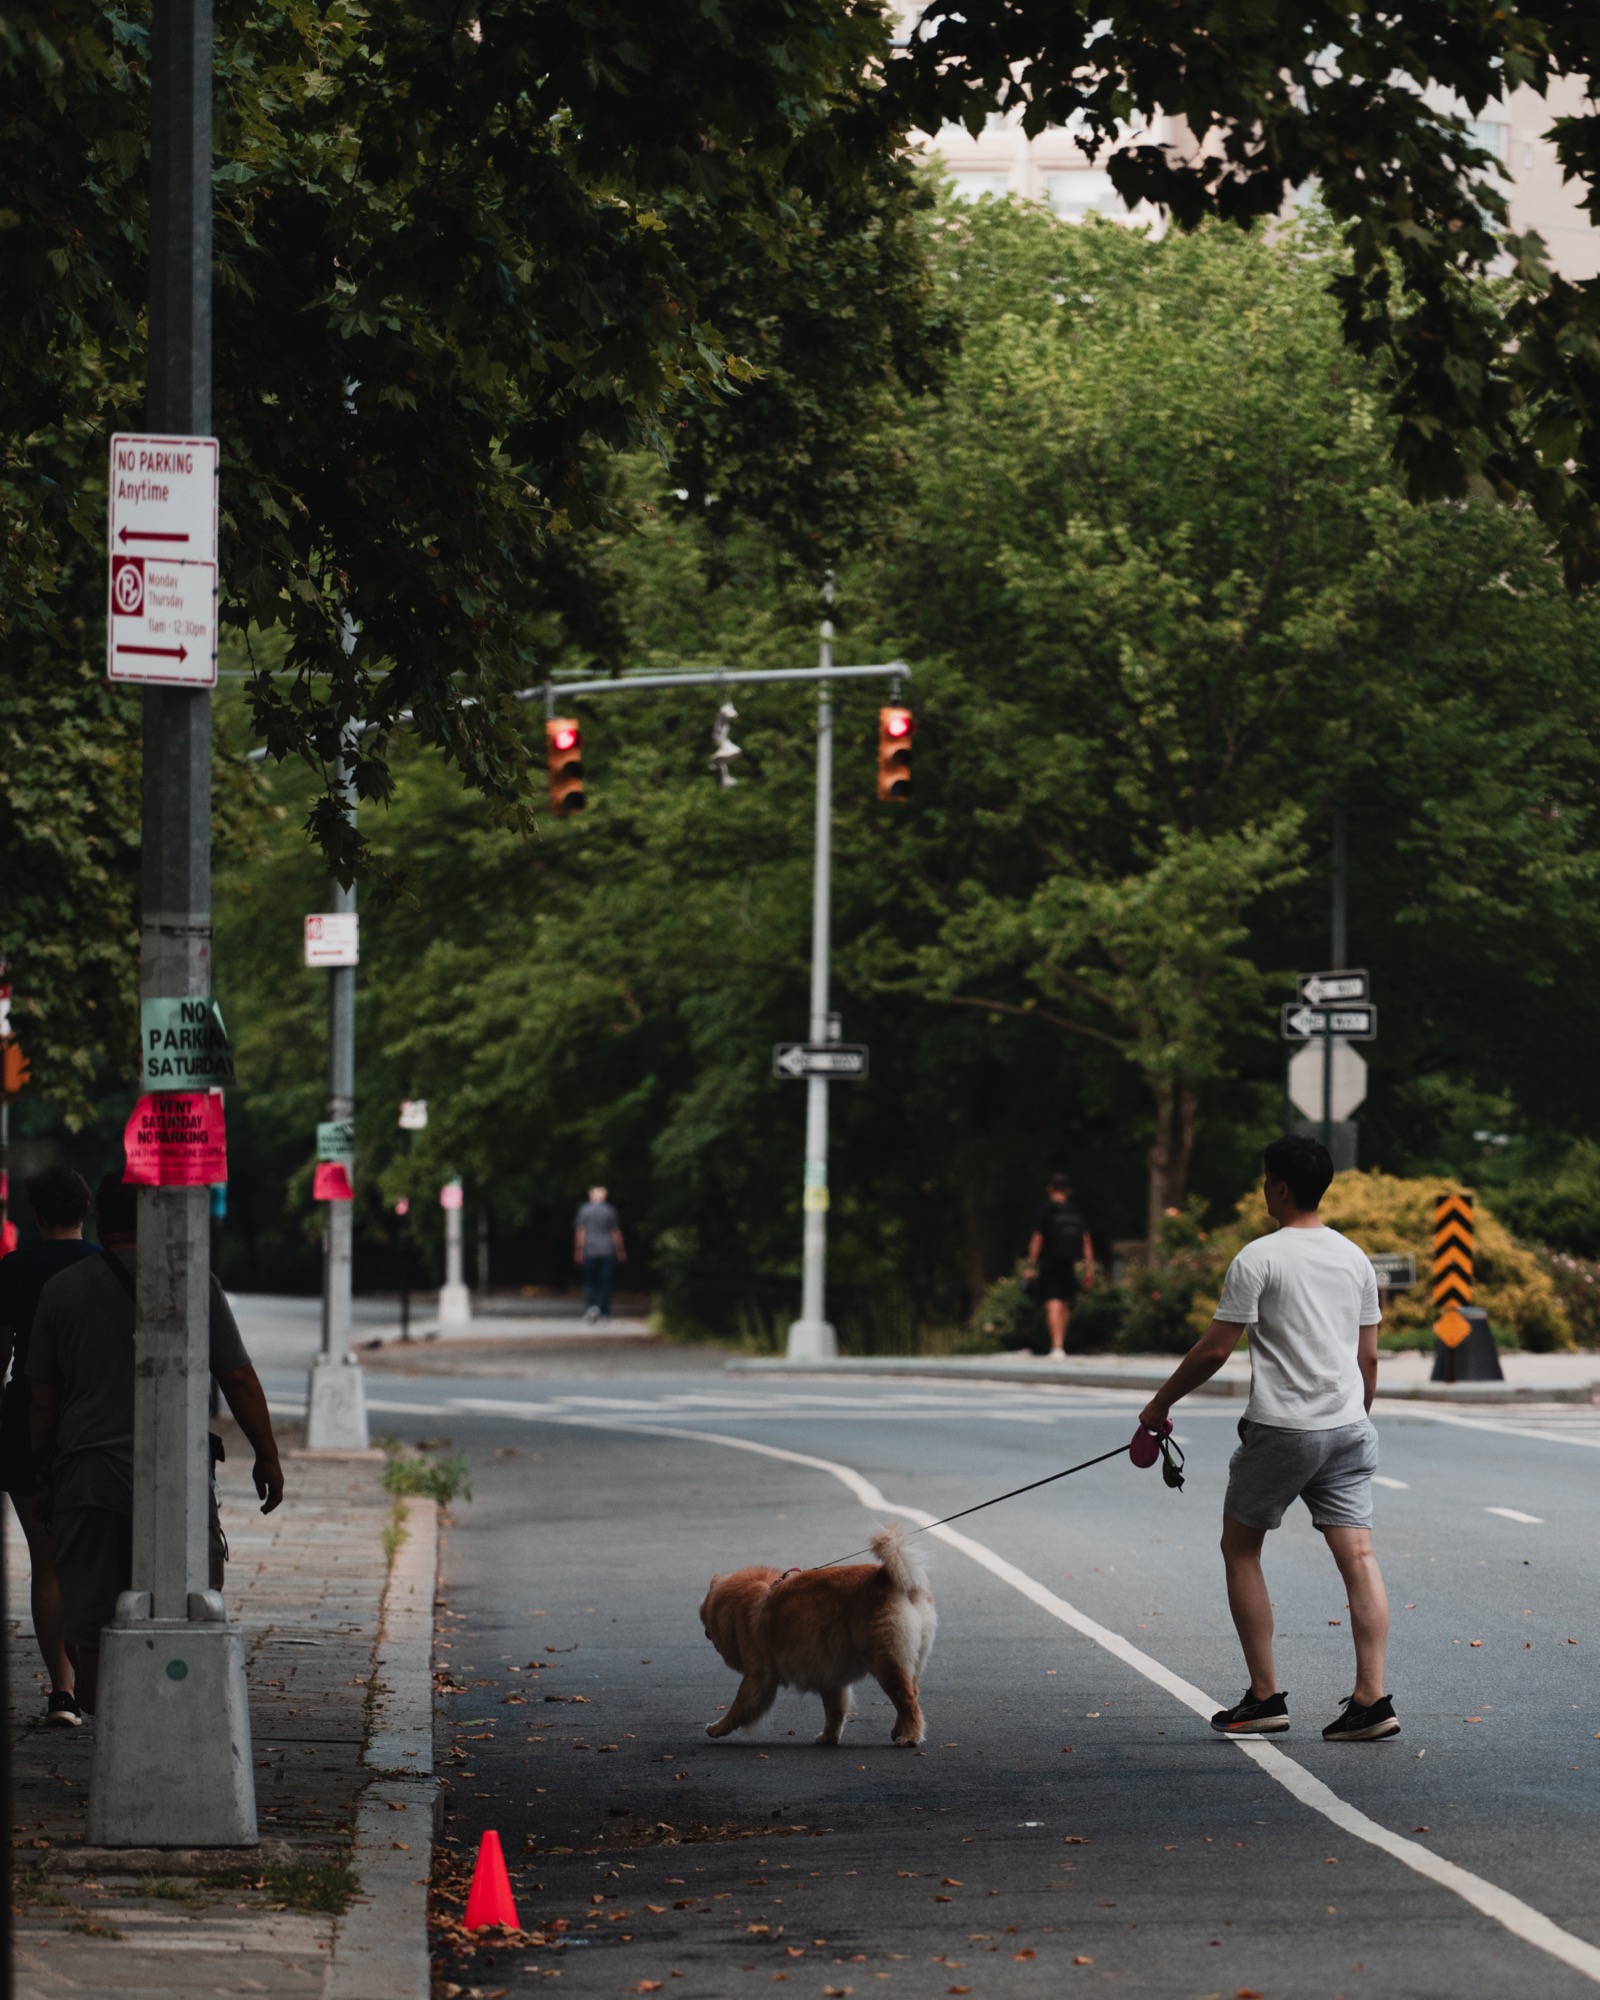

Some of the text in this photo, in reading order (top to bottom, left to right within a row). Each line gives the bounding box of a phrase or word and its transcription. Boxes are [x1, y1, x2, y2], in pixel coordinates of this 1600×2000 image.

[118, 450, 193, 475] NO PARKING
[118, 479, 169, 505] Anytime
[148, 573, 179, 589] Monday
[148, 591, 184, 610] Thursday
[148, 619, 166, 633] 11am
[174, 620, 206, 637] 12:30pm
[180, 1001, 207, 1023] NO
[152, 1100, 193, 1114] EVENT
[142, 1115, 203, 1130] SATURDAY
[137, 1130, 209, 1145] NO PARKING
